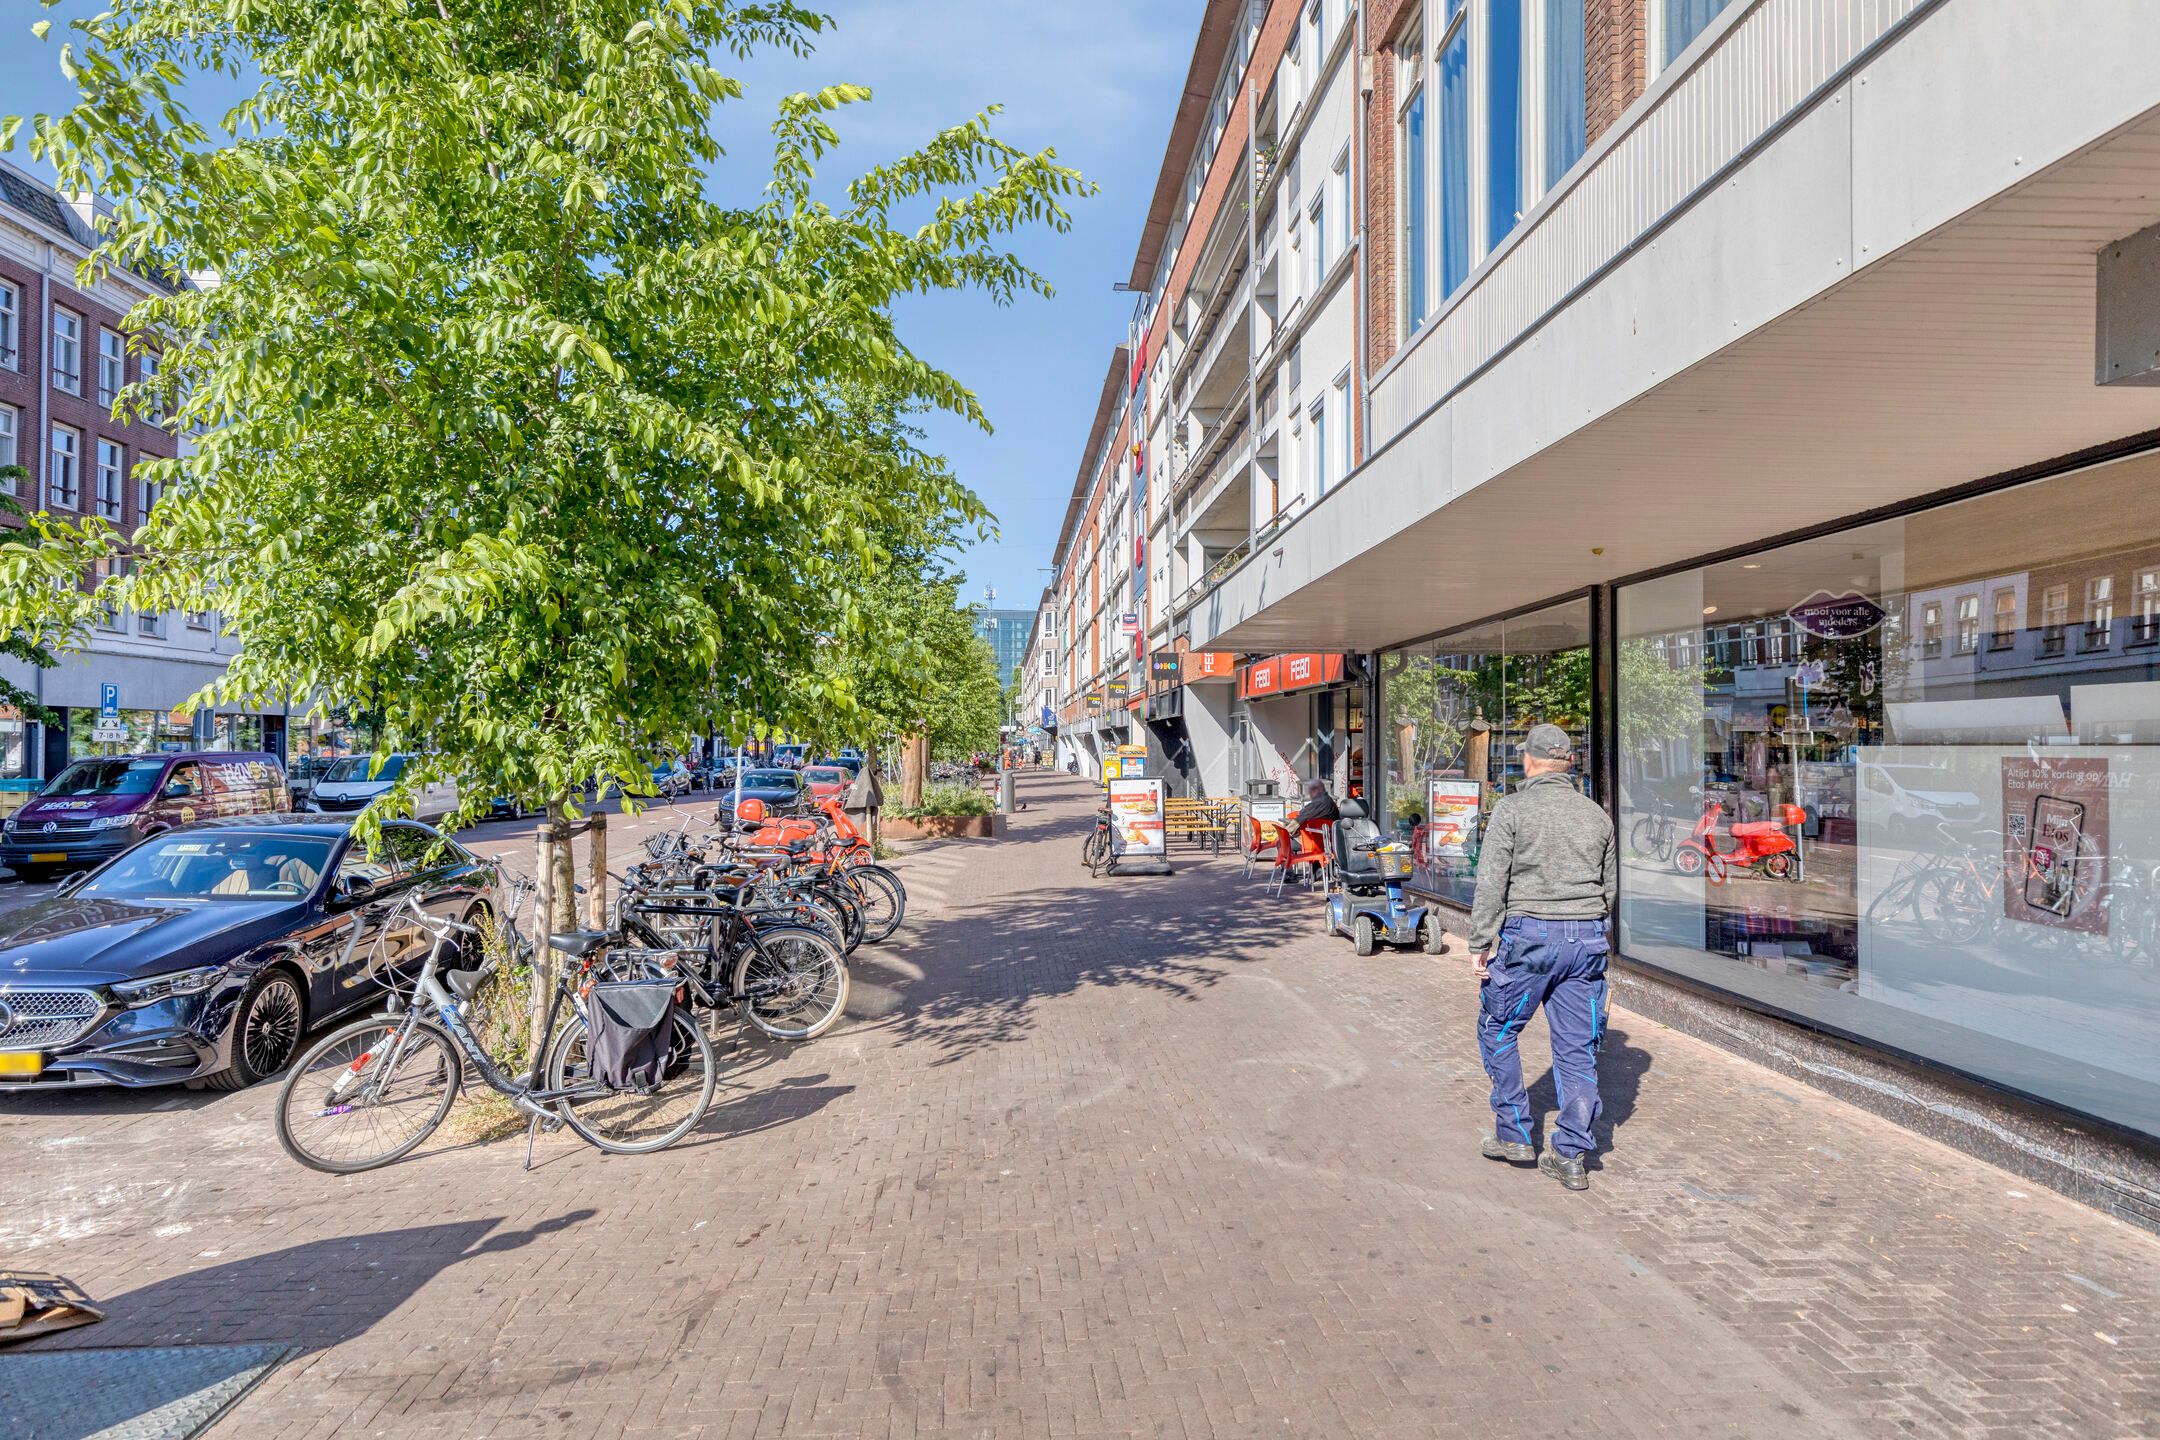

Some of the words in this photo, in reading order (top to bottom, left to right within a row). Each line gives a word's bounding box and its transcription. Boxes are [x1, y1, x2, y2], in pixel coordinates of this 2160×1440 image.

[1804, 606, 1829, 616] mooi
[1830, 608, 1852, 616] voor
[1853, 606, 1870, 616] alle
[1290, 656, 1310, 680] FEBO
[1255, 668, 1270, 689] FEBO
[106, 686, 116, 704] P
[221, 761, 268, 780] HANOS
[2008, 768, 2030, 780] Altijd
[2032, 768, 2049, 779] 10%
[2051, 769, 2084, 783] korting
[2085, 771, 2099, 783] op
[2008, 779, 2026, 789] Etos
[37, 801, 97, 811] HANOS
[2047, 813, 2069, 828] Mijn
[2043, 824, 2069, 842] Etos
[444, 1006, 487, 1064] GIANT
